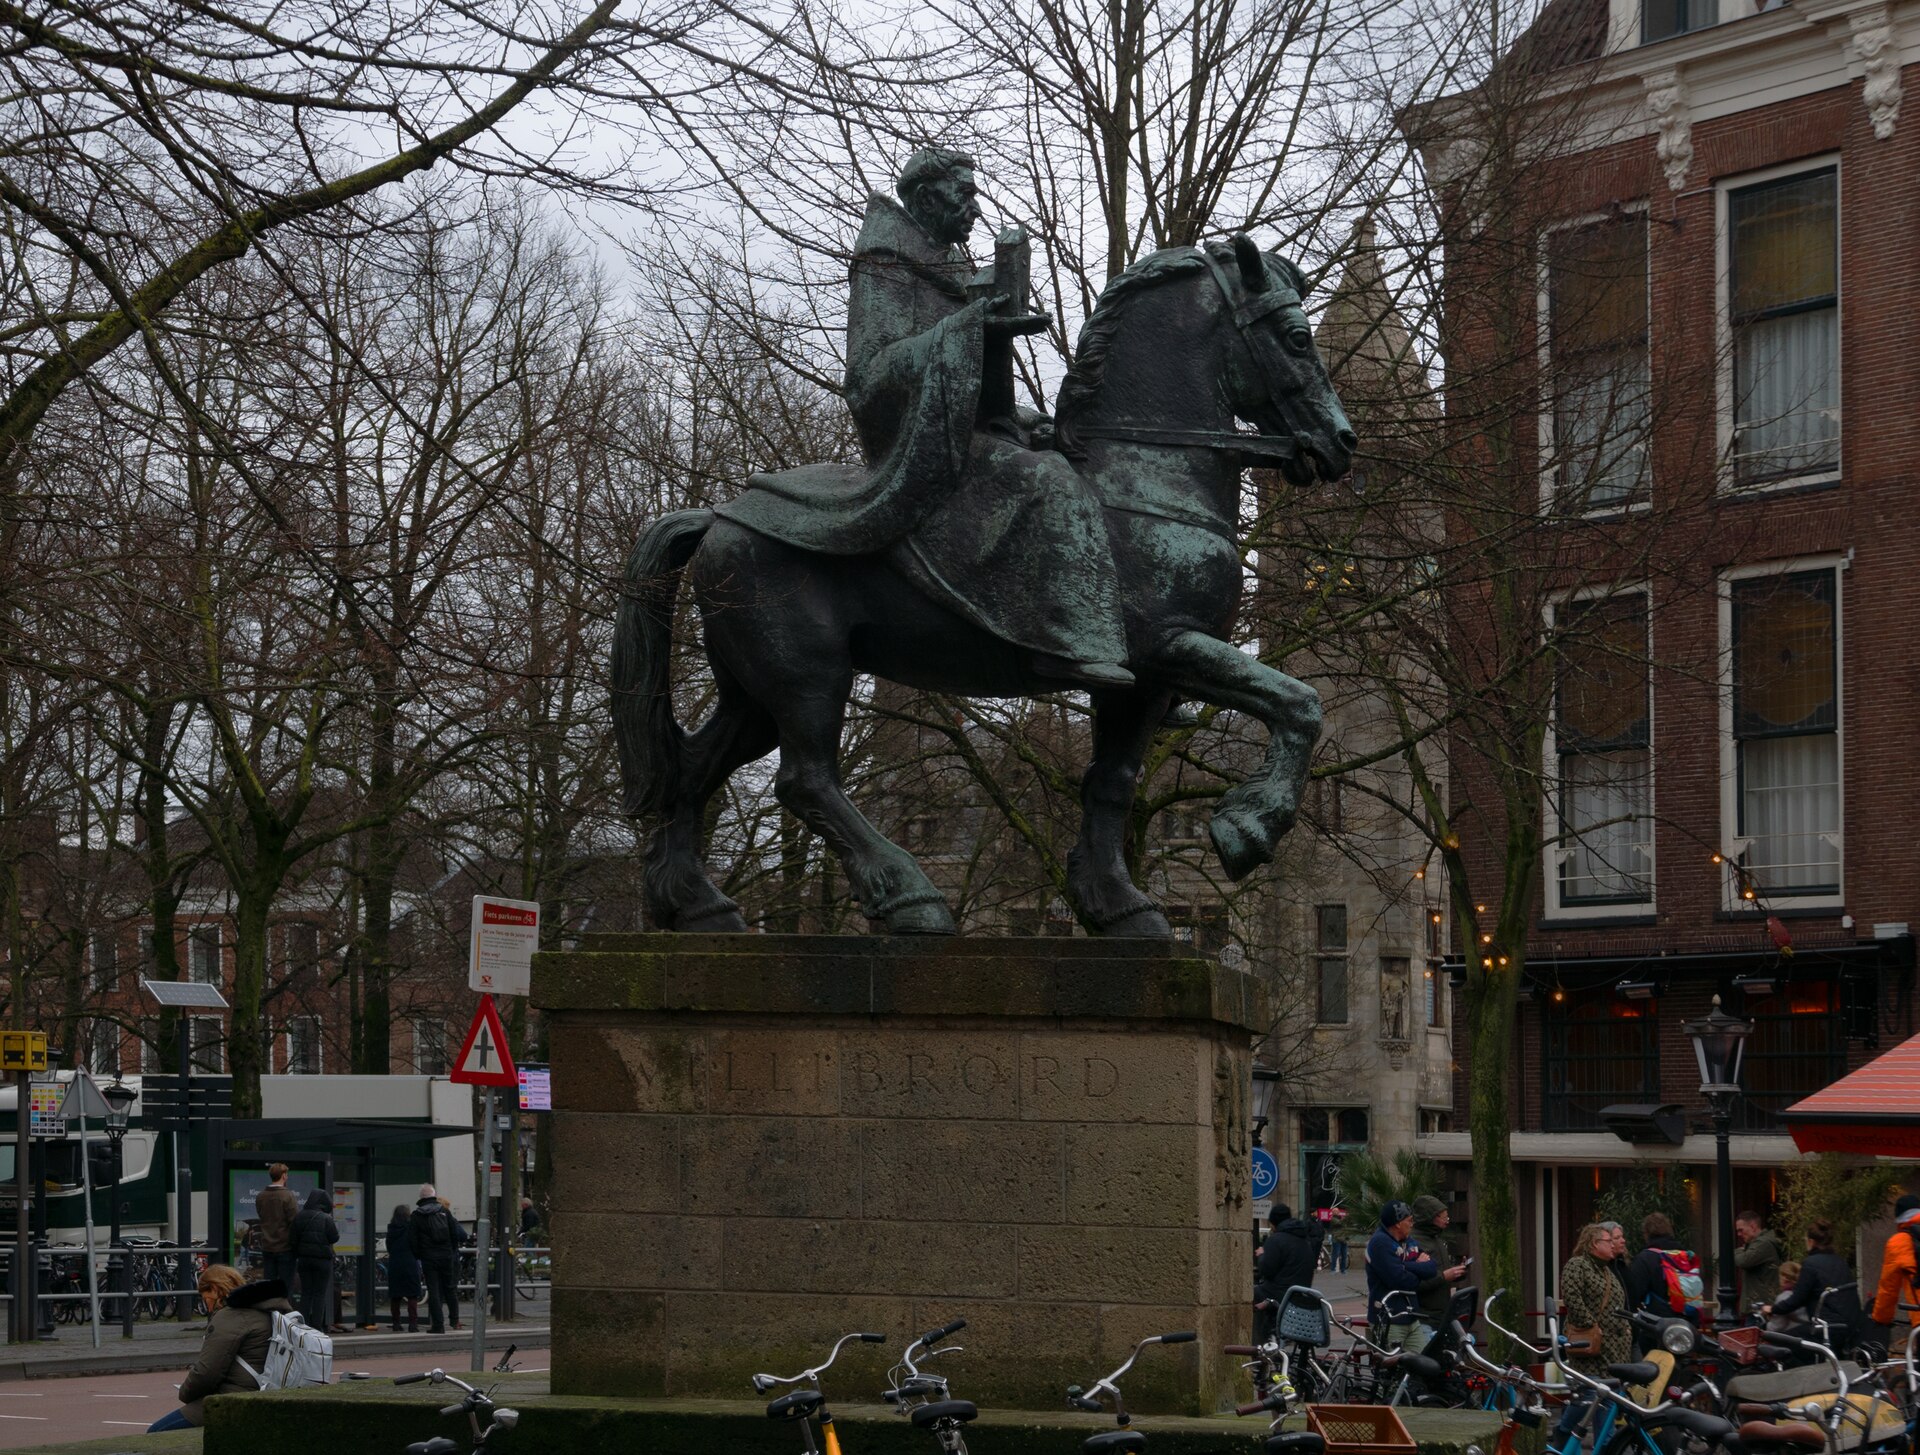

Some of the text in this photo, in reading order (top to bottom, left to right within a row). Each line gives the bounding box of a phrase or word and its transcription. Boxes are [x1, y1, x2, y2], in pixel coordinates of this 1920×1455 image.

[484, 911, 522, 922] Fiets parkeren
[621, 1050, 1119, 1098] WILLIBRORD
